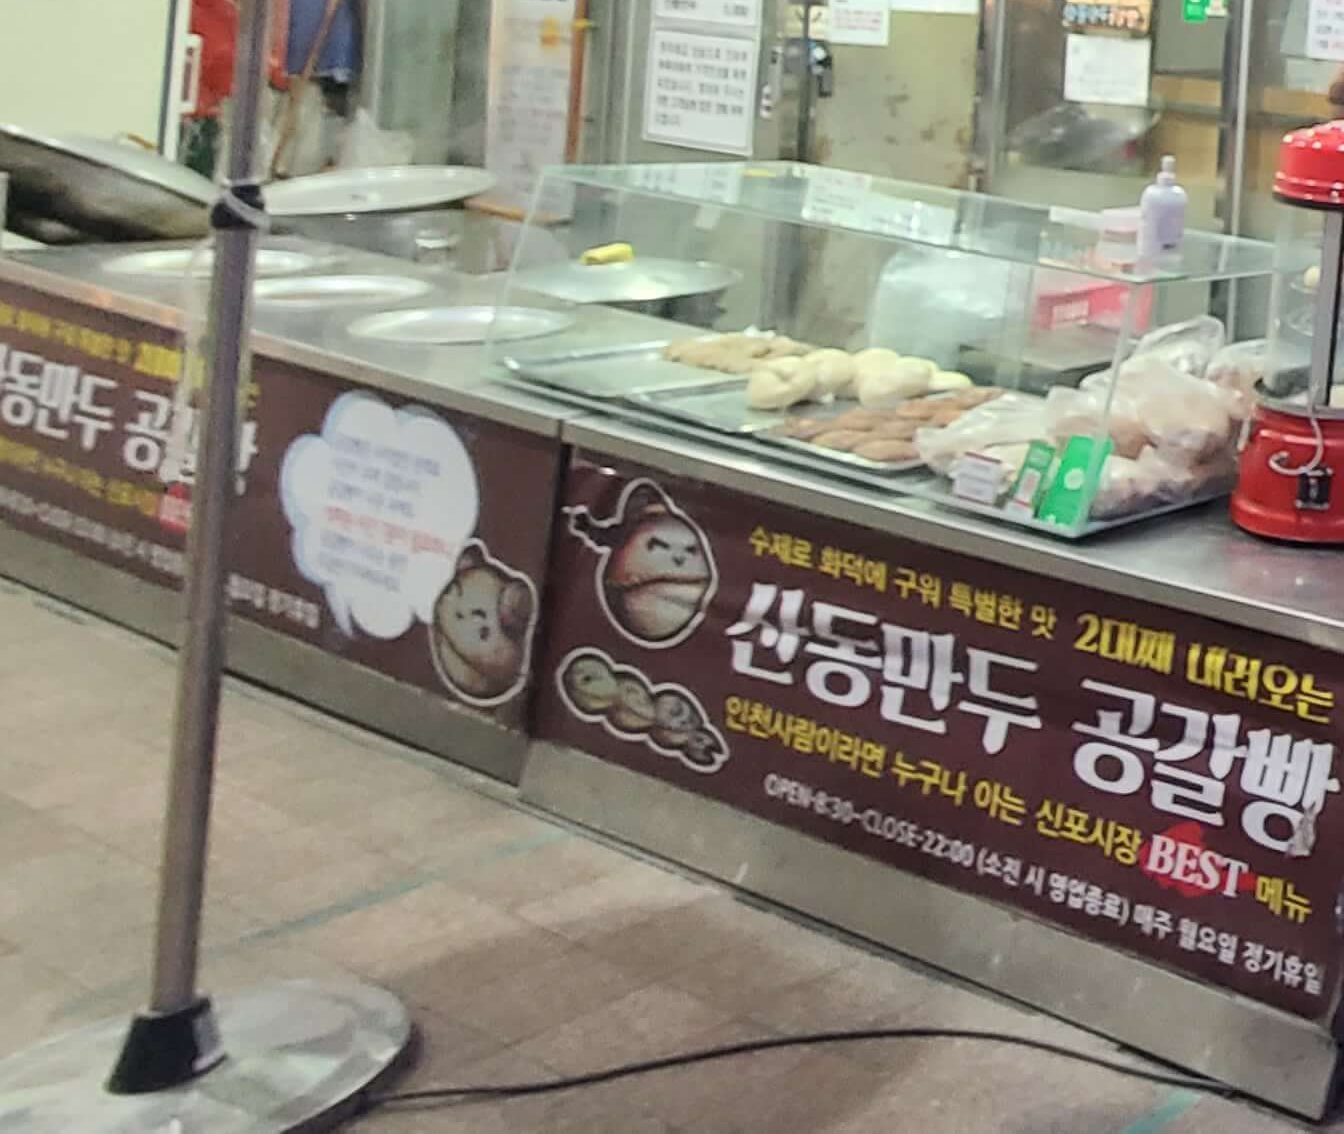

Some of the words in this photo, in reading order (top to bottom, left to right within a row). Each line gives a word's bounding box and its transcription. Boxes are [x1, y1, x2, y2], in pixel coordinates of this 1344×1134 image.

[0, 343, 118, 450] 동만두
[726, 582, 1043, 755] 산동만두
[1071, 677, 1342, 859] 공갈빵
[749, 525, 813, 570] 수제로
[895, 568, 941, 609] 구워
[948, 580, 1025, 632] 특별한
[1030, 602, 1058, 642] 맛
[1074, 613, 1175, 676] 2대째
[1186, 642, 1335, 725] 내려오는
[724, 695, 887, 780] 인천사람이라면
[892, 751, 967, 807] 누구나
[974, 777, 1026, 827] 아는
[1035, 801, 1144, 865] 신포시장
[1147, 833, 1250, 900] BEST
[1255, 874, 1312, 925] 메뉴
[1177, 915, 1239, 965] 월요일
[1242, 937, 1324, 996] 정기휴일
